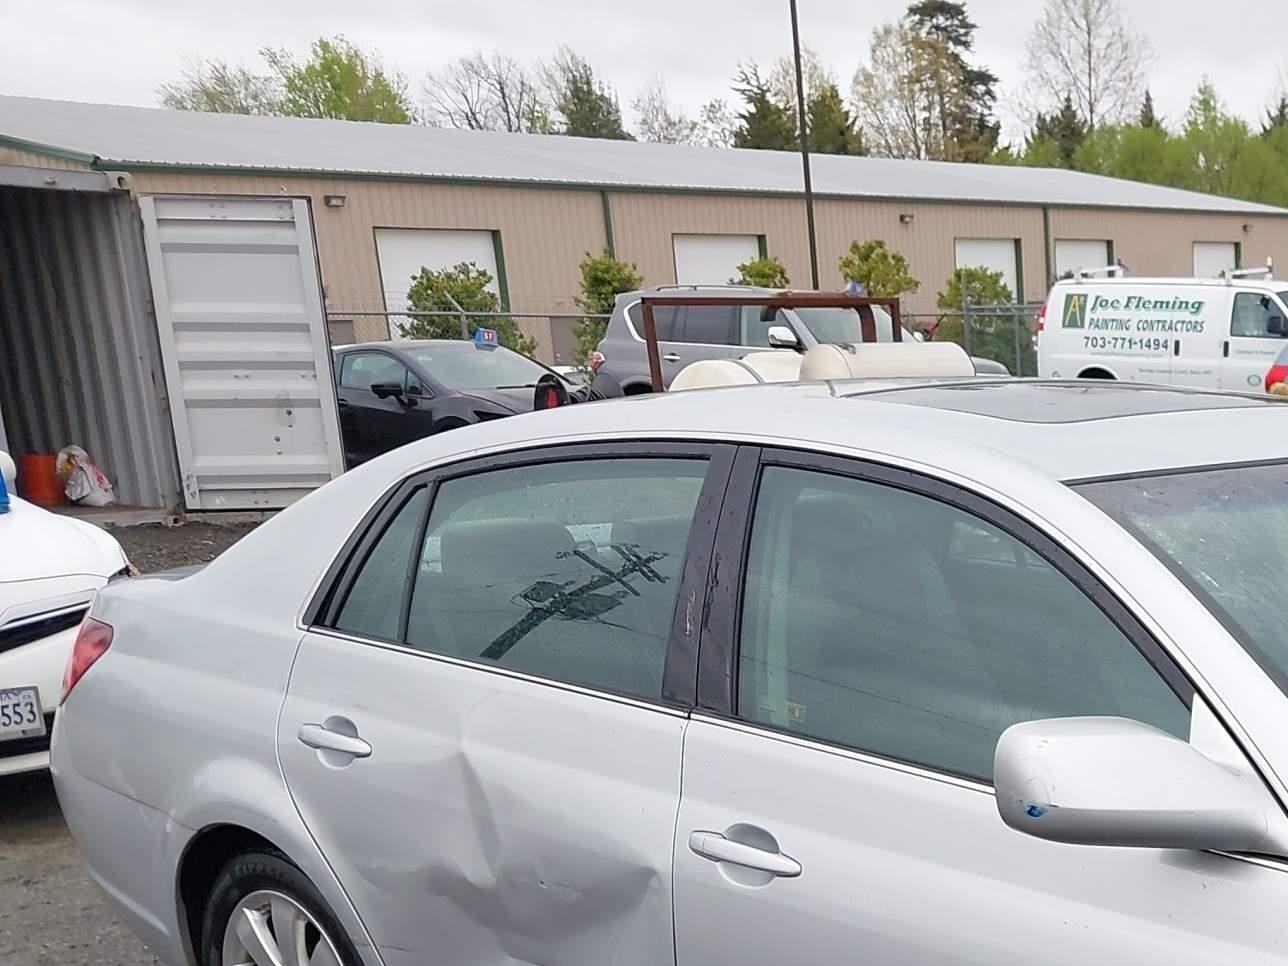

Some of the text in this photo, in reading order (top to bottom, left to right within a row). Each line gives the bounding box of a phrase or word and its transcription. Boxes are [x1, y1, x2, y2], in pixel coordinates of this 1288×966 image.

[1090, 295, 1206, 315] Joe Fleming
[1088, 318, 1206, 333] PAINTING CONTRACTORS
[1084, 336, 1169, 351] 703-771-1494
